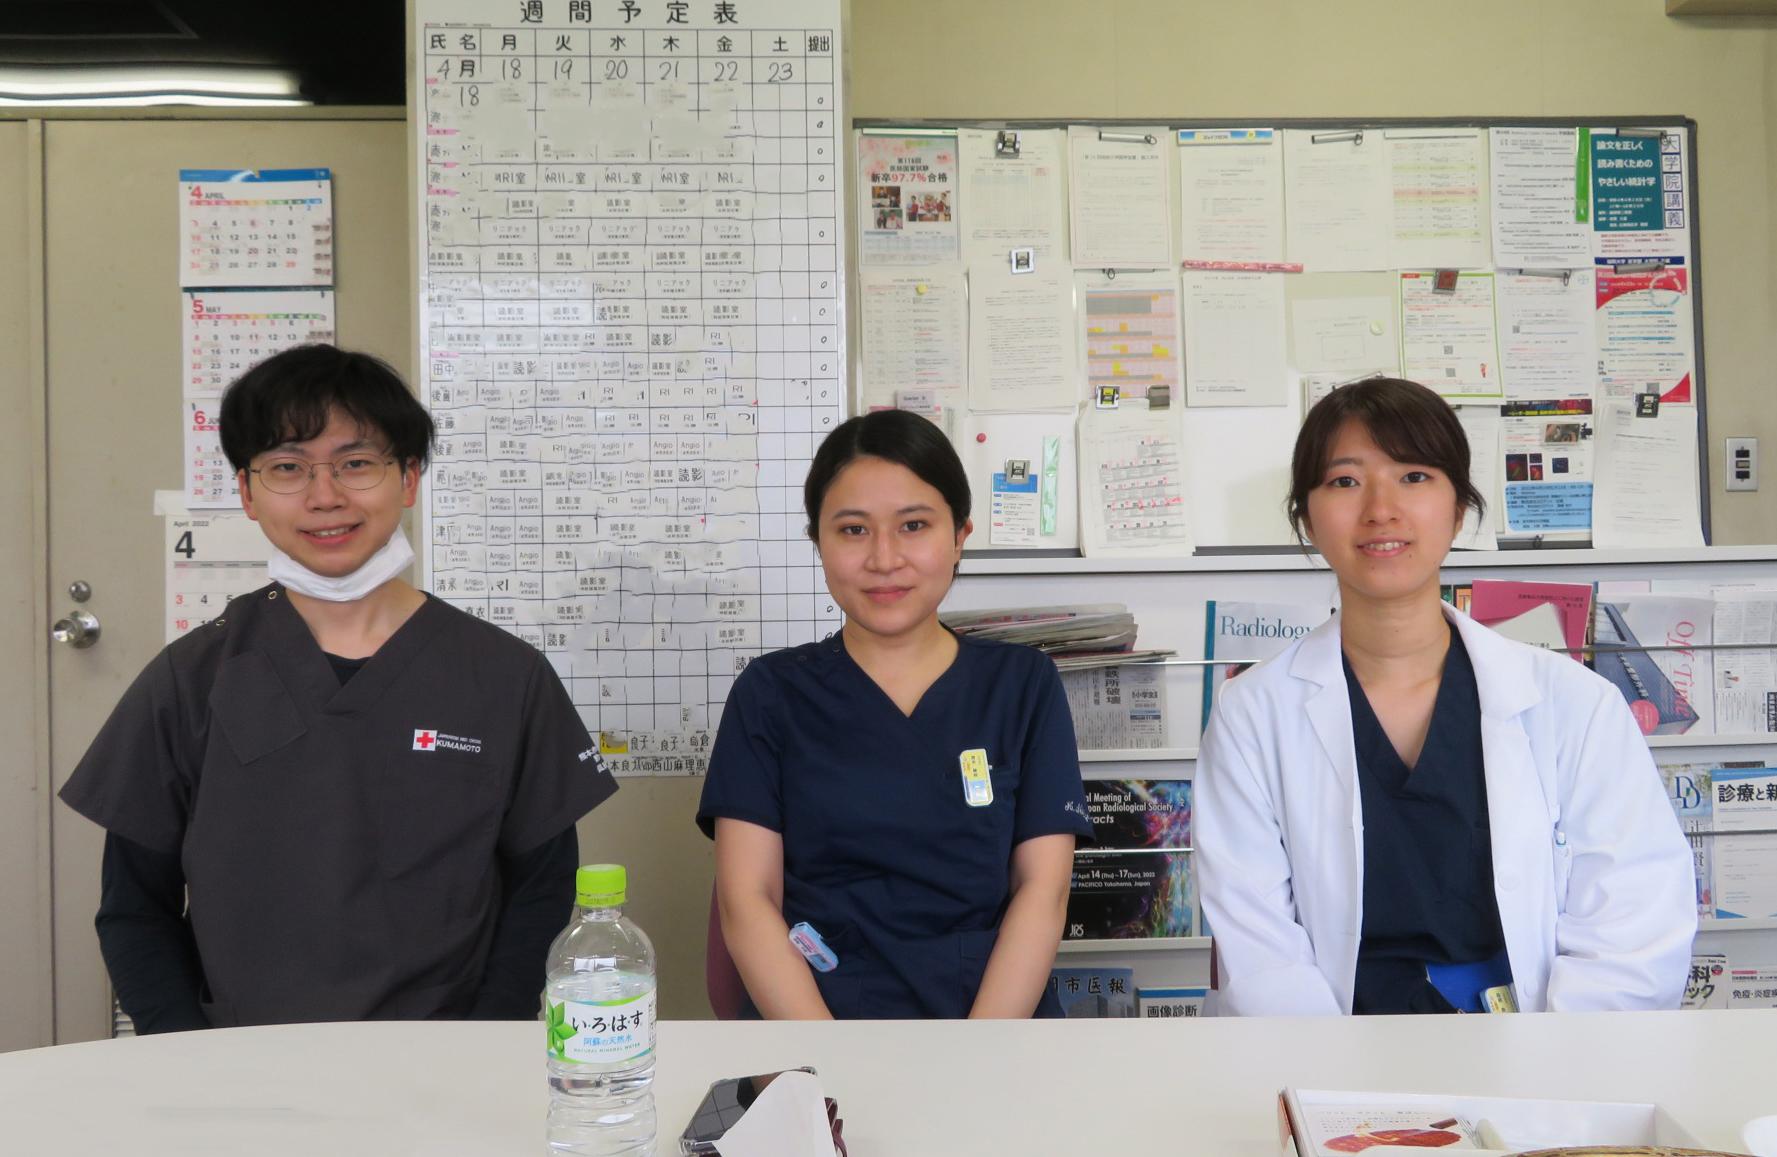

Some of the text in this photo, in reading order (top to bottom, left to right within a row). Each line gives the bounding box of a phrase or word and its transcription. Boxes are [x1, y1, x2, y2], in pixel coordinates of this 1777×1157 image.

[520, 1, 739, 25] 週間予定表
[501, 33, 517, 51] 月
[556, 35, 572, 51] 火
[610, 35, 626, 51] 水
[663, 35, 680, 51] 木
[717, 35, 733, 51] 金
[773, 36, 788, 51] 土
[501, 58, 522, 80] 18
[554, 58, 573, 80] 19
[605, 59, 629, 80] 20
[659, 60, 680, 80] 21
[714, 61, 739, 82] 22
[768, 62, 793, 83] 23
[460, 86, 479, 106] 18
[871, 173, 947, 183] 新卒97.7%合格
[191, 186, 203, 199] 4
[192, 300, 203, 314] 5
[194, 410, 206, 425] 6
[175, 531, 195, 559] 4
[176, 594, 208, 604] 3 4
[176, 620, 188, 630] 10
[436, 739, 481, 753] KUMAMOTO
[1094, 793, 1122, 803] Meeting
[1124, 792, 1131, 802] of
[1103, 802, 1146, 813] Radiological
[1149, 803, 1173, 813] Society
[1090, 814, 1114, 824] acts
[1091, 870, 1100, 879] 14
[1687, 965, 1711, 983] 科
[1147, 1005, 1198, 1017] 画像診断
